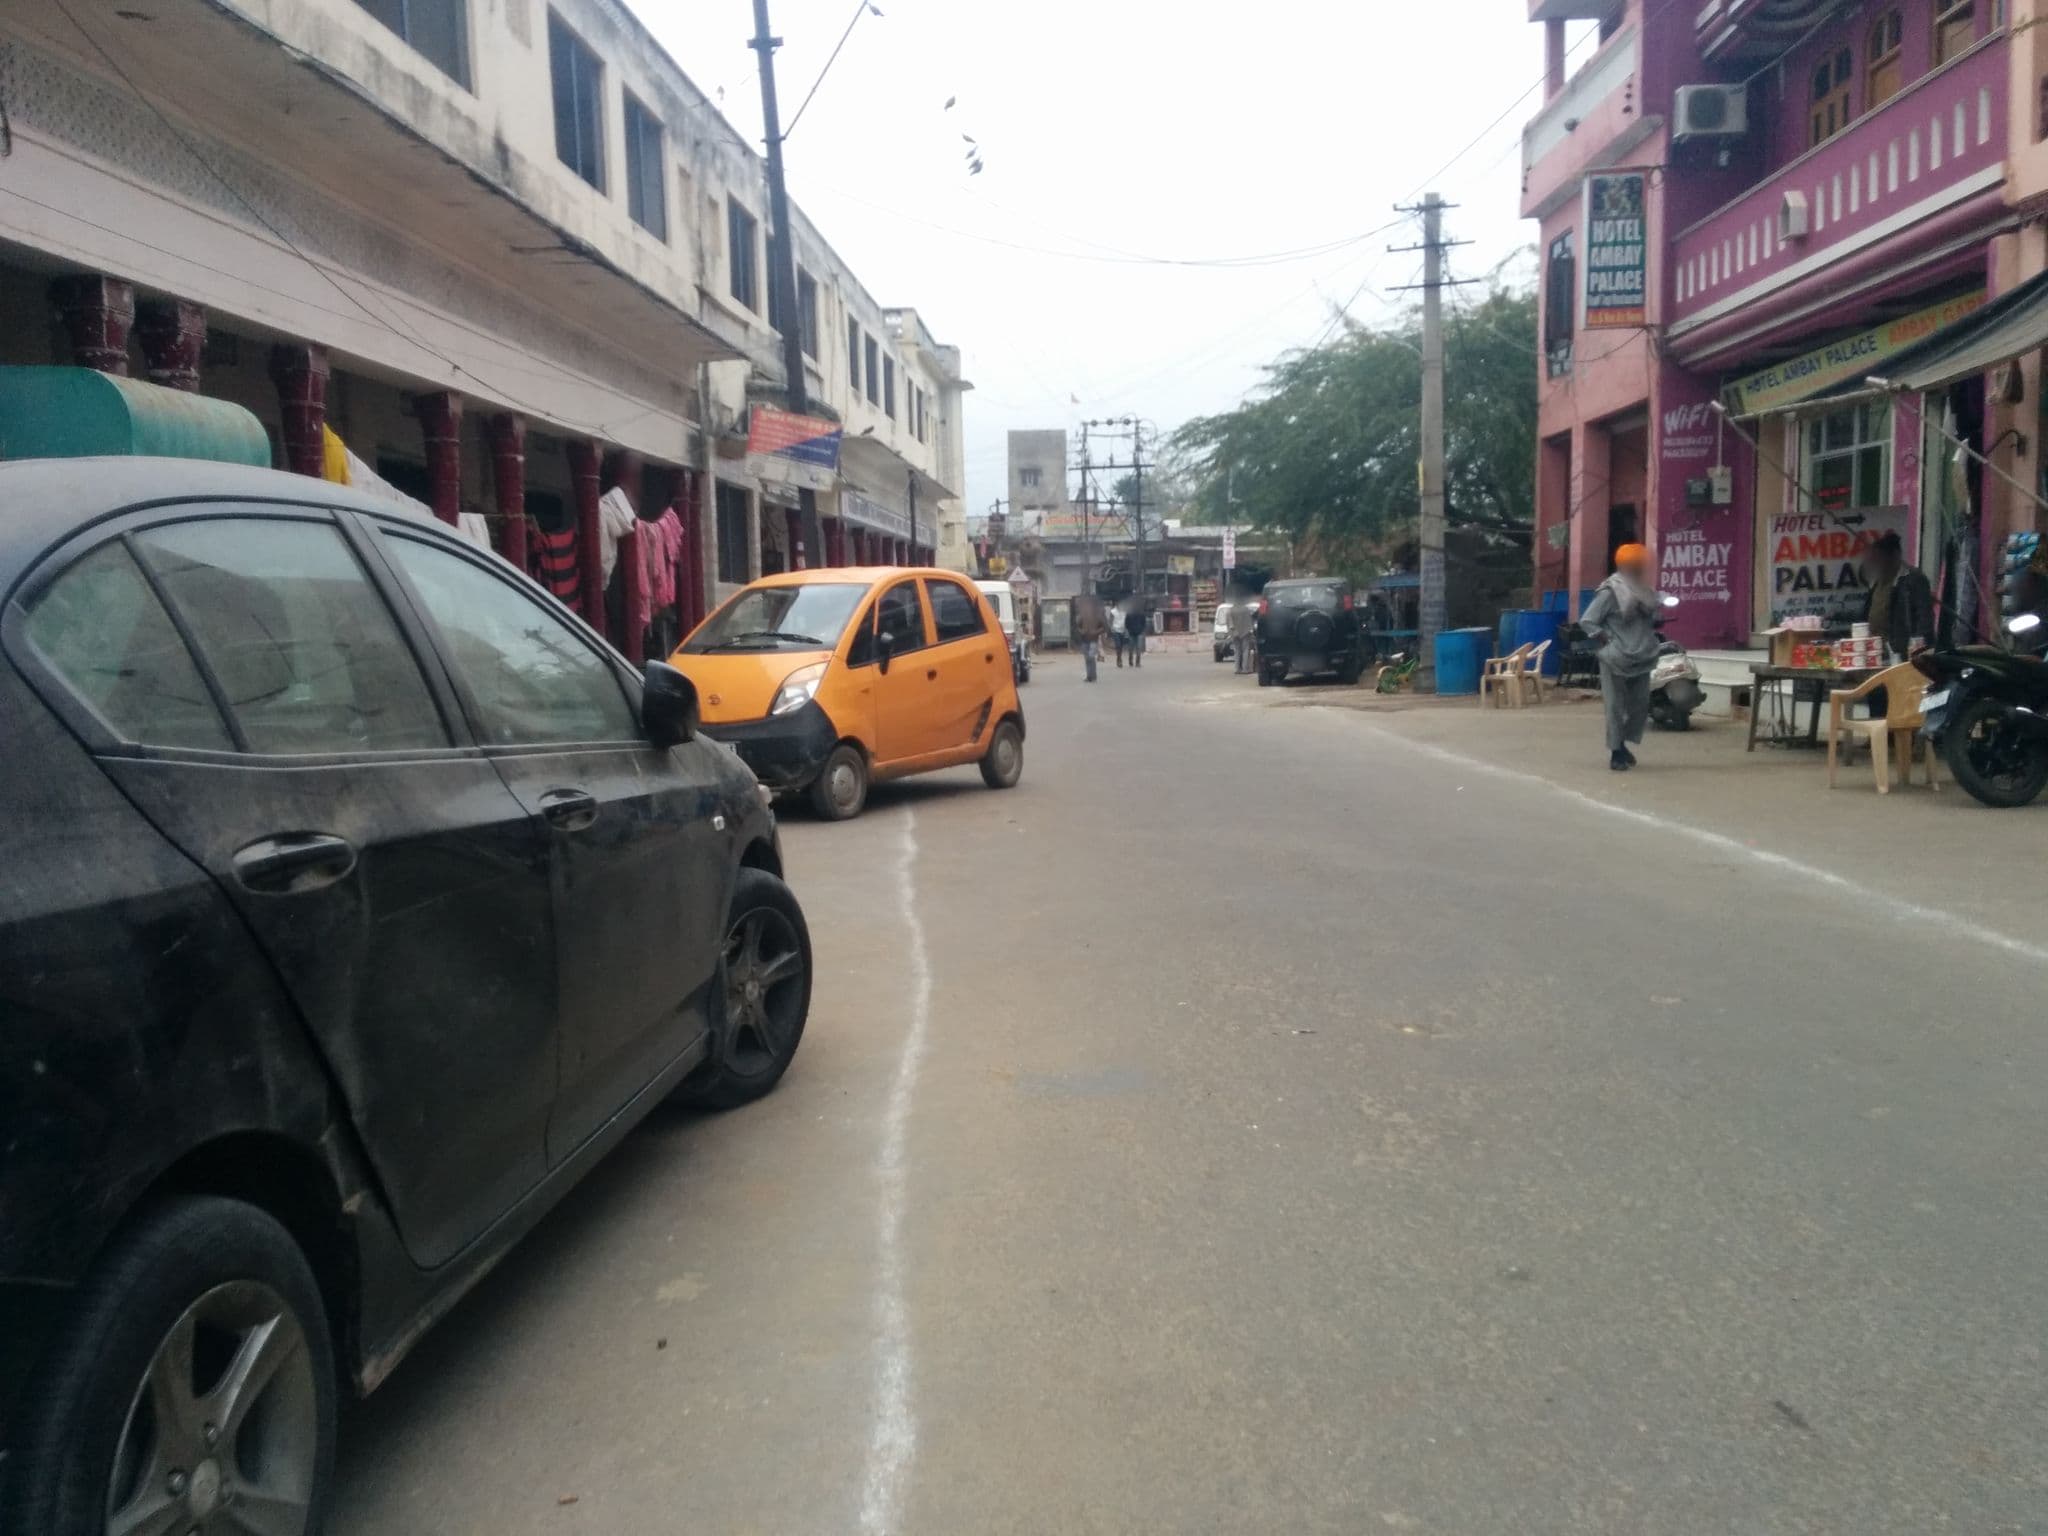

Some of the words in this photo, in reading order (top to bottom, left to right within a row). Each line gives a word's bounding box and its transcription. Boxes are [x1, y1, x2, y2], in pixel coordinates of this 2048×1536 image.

[1592, 219, 1641, 242] HOTEL
[1590, 245, 1642, 267] AMBAY
[1589, 270, 1642, 292] PALACE
[1746, 370, 1780, 393] HOTEL
[1783, 352, 1823, 382] AMBAY
[1826, 335, 1878, 366] PALACE
[1775, 514, 1824, 533] HOTEL
[1666, 530, 1706, 543] HOTEL
[1662, 543, 1732, 568] AMBAY
[1661, 569, 1727, 588] PALACE
